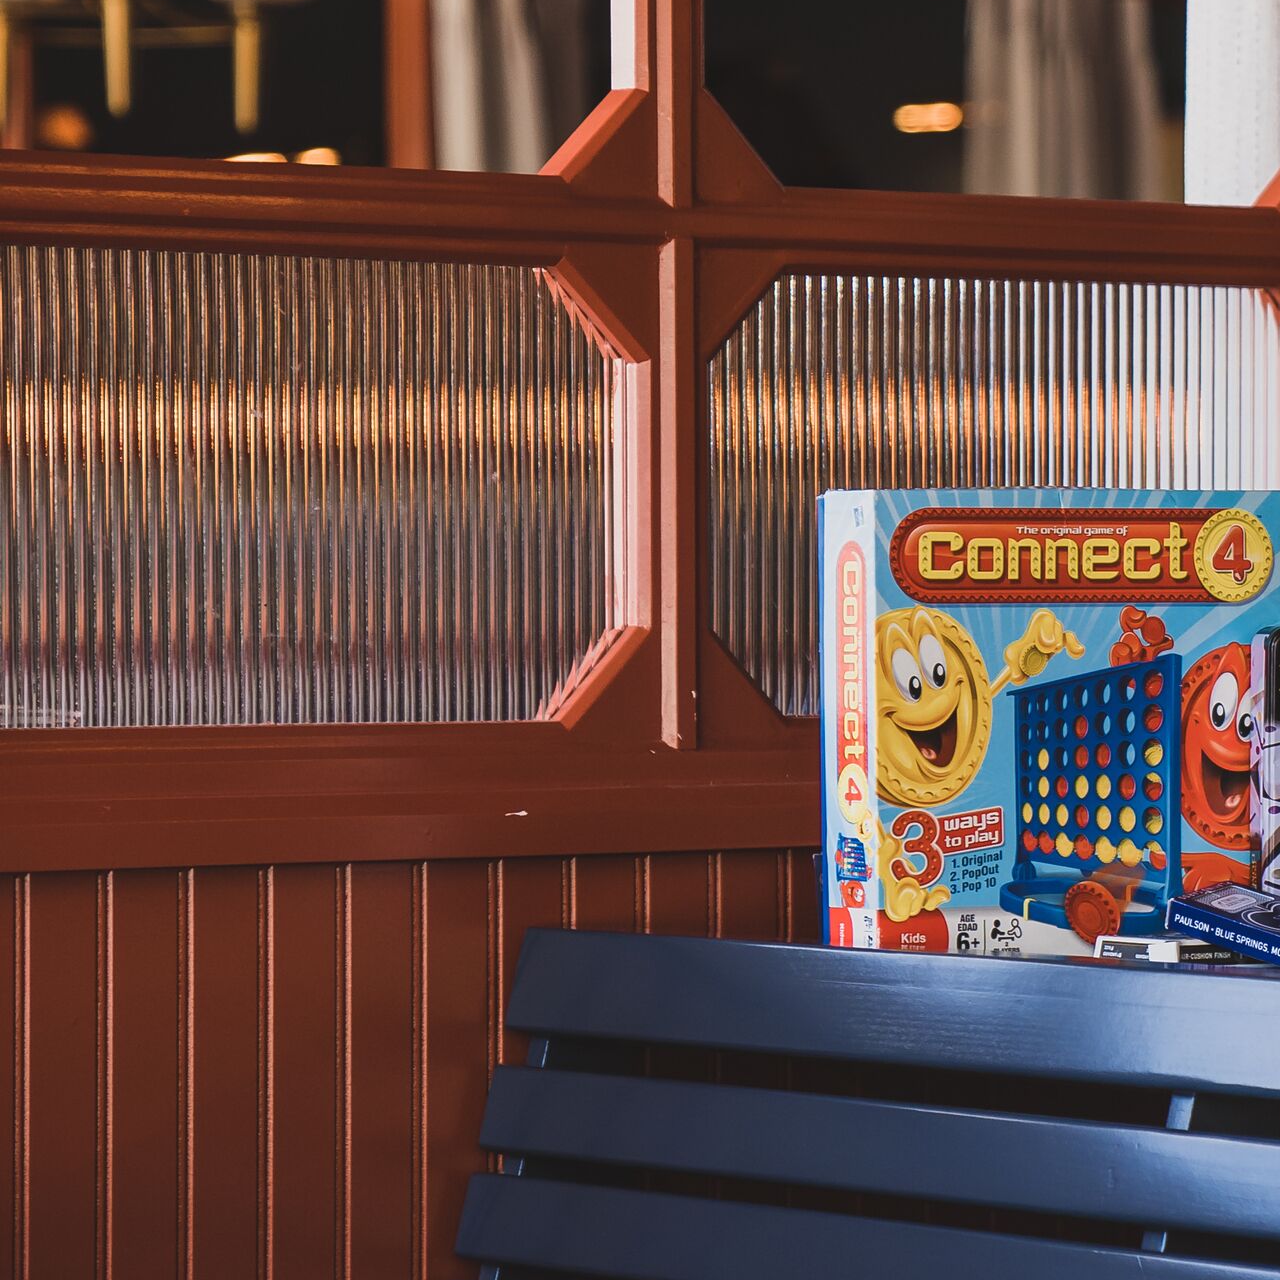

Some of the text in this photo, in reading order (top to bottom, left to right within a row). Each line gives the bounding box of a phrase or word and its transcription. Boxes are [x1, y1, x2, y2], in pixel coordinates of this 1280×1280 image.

[1016, 526, 1128, 537] The original game of
[918, 522, 1253, 584] Connect 4
[843, 559, 864, 806] Connect 4
[944, 810, 999, 832] ways
[944, 830, 999, 848] to play
[890, 809, 944, 888] 3
[952, 850, 1003, 869] 1. Original
[950, 866, 999, 882] 2. PopOut
[950, 877, 997, 894] 3. Pop 10
[958, 923, 978, 932] EDAD
[960, 914, 975, 923] AGE
[1174, 913, 1209, 933] PAULSON
[1215, 927, 1235, 942] BLUE
[901, 933, 926, 944] Kids
[956, 932, 981, 952] 6+
